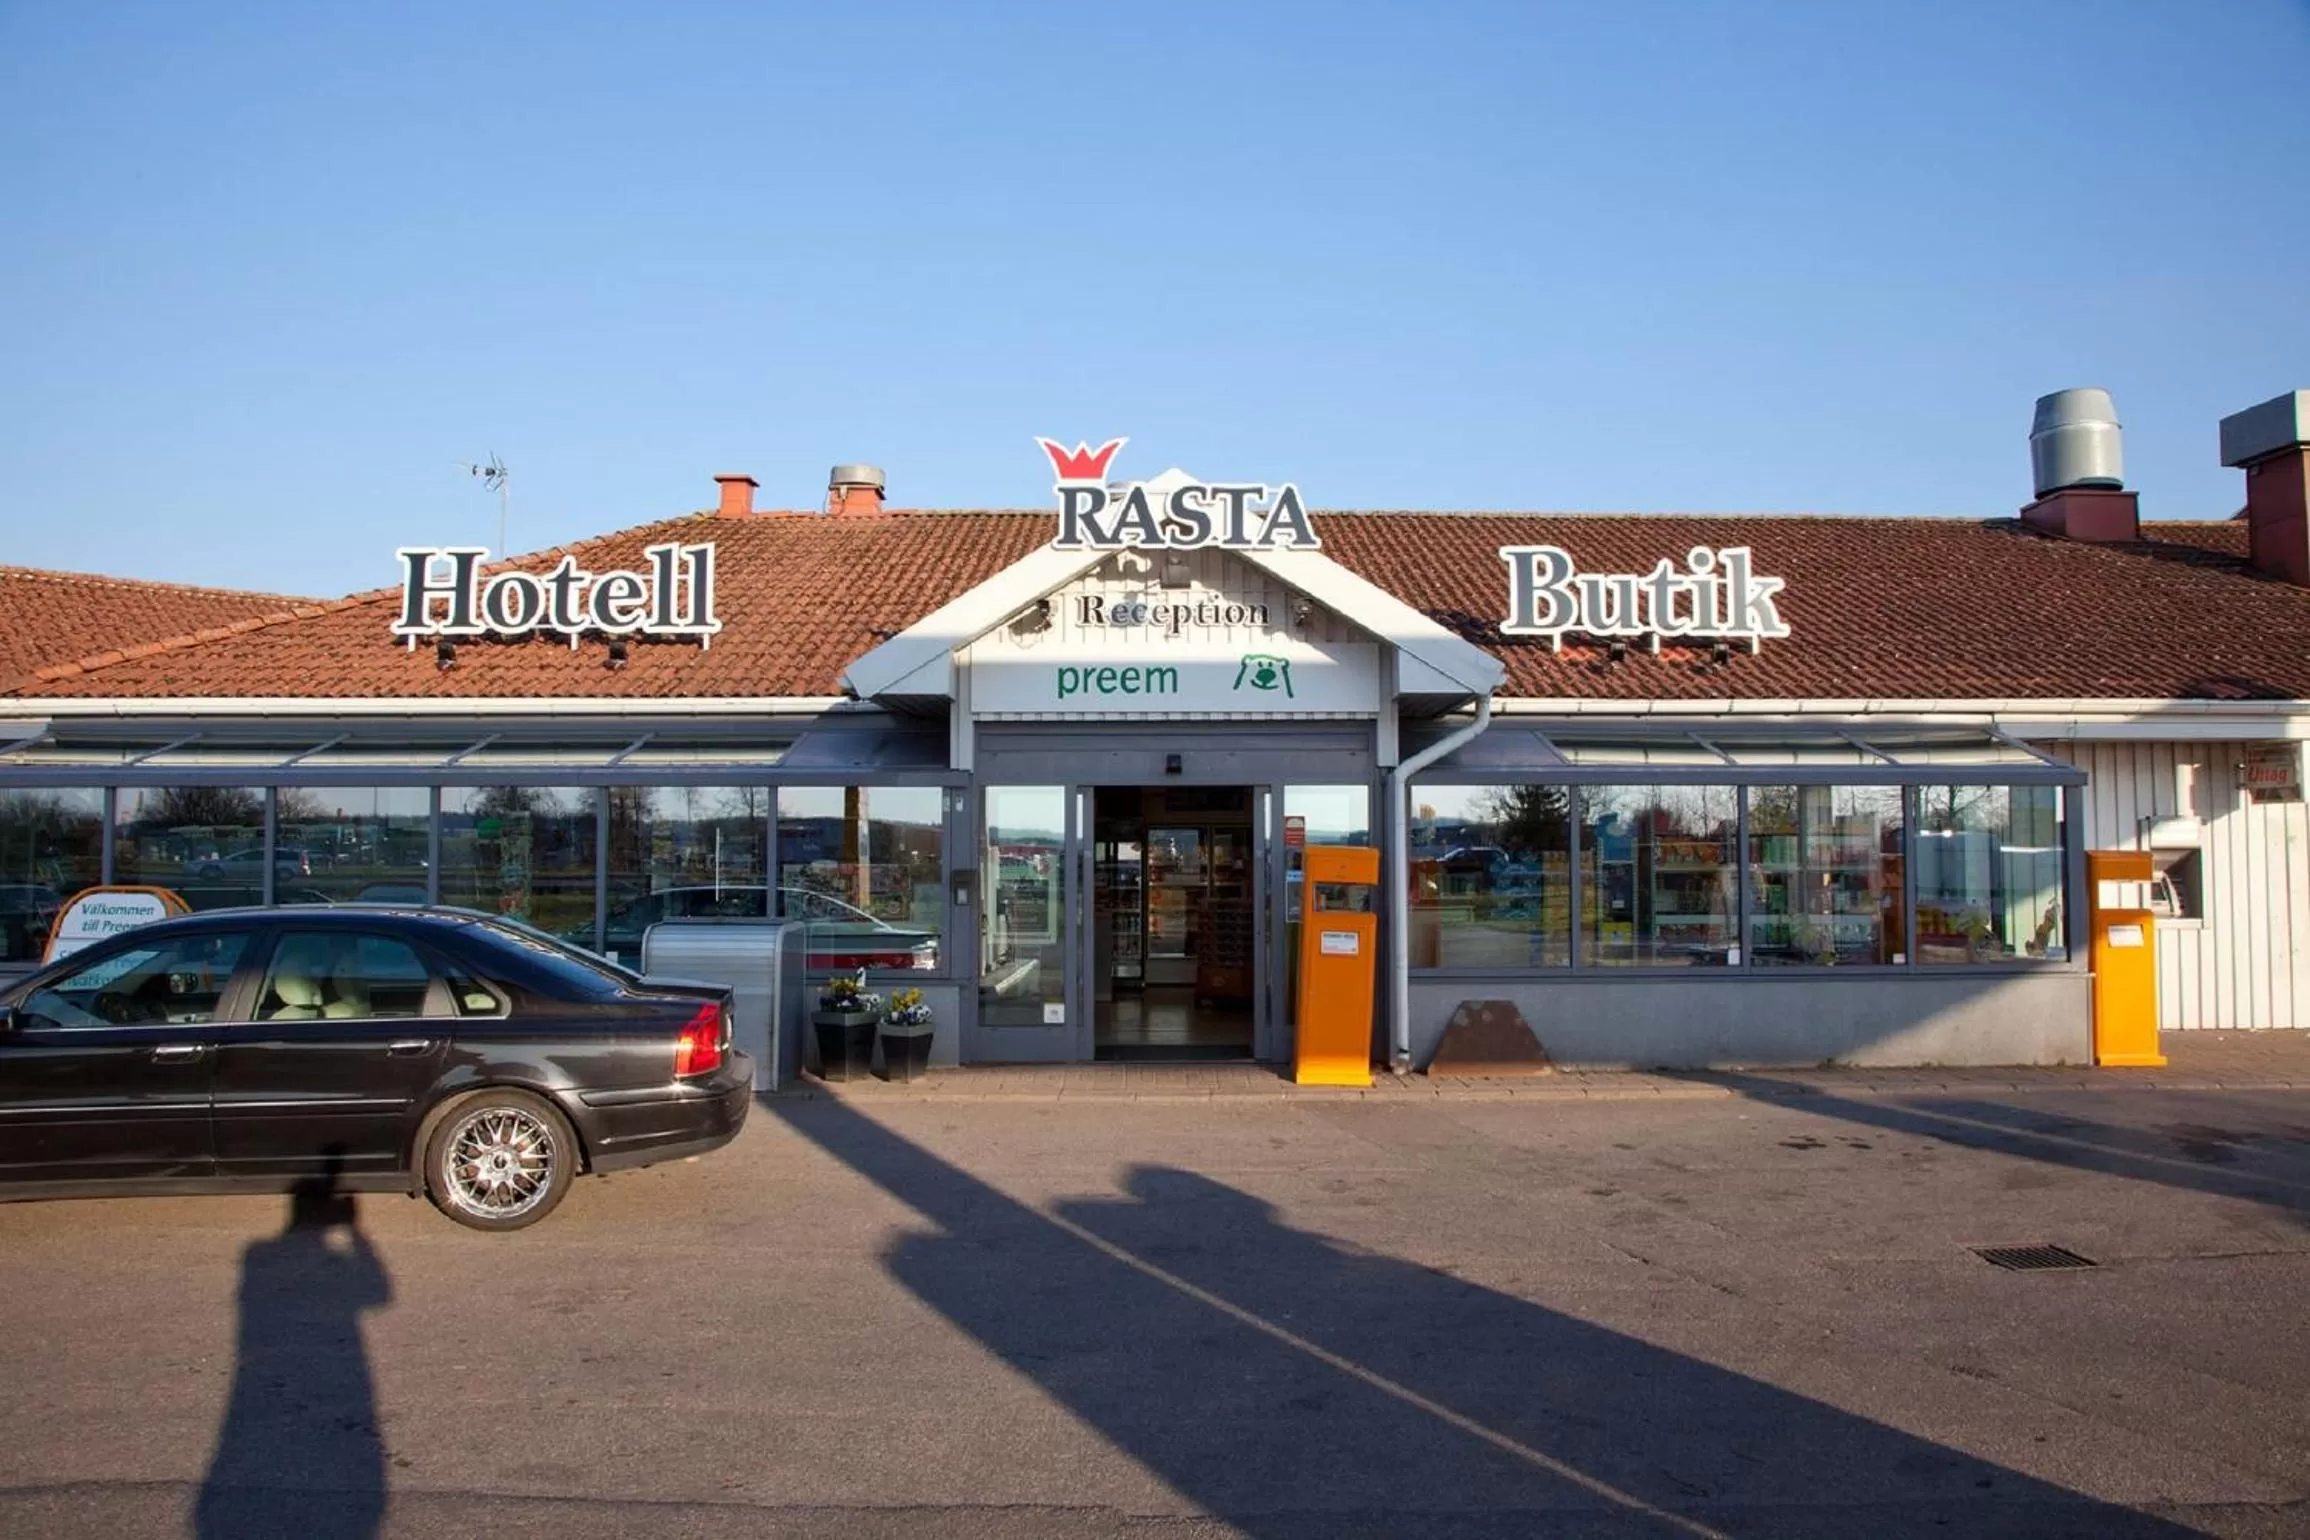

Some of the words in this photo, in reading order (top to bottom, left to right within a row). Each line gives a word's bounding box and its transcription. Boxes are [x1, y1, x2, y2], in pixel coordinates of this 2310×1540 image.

[1054, 484, 1319, 547] RASTA
[394, 542, 720, 632] Hotell
[1501, 547, 1788, 635] Butik
[1079, 594, 1271, 635] Reception
[1058, 666, 1179, 699] preem
[82, 903, 154, 916] Välkommen
[82, 919, 100, 932] till
